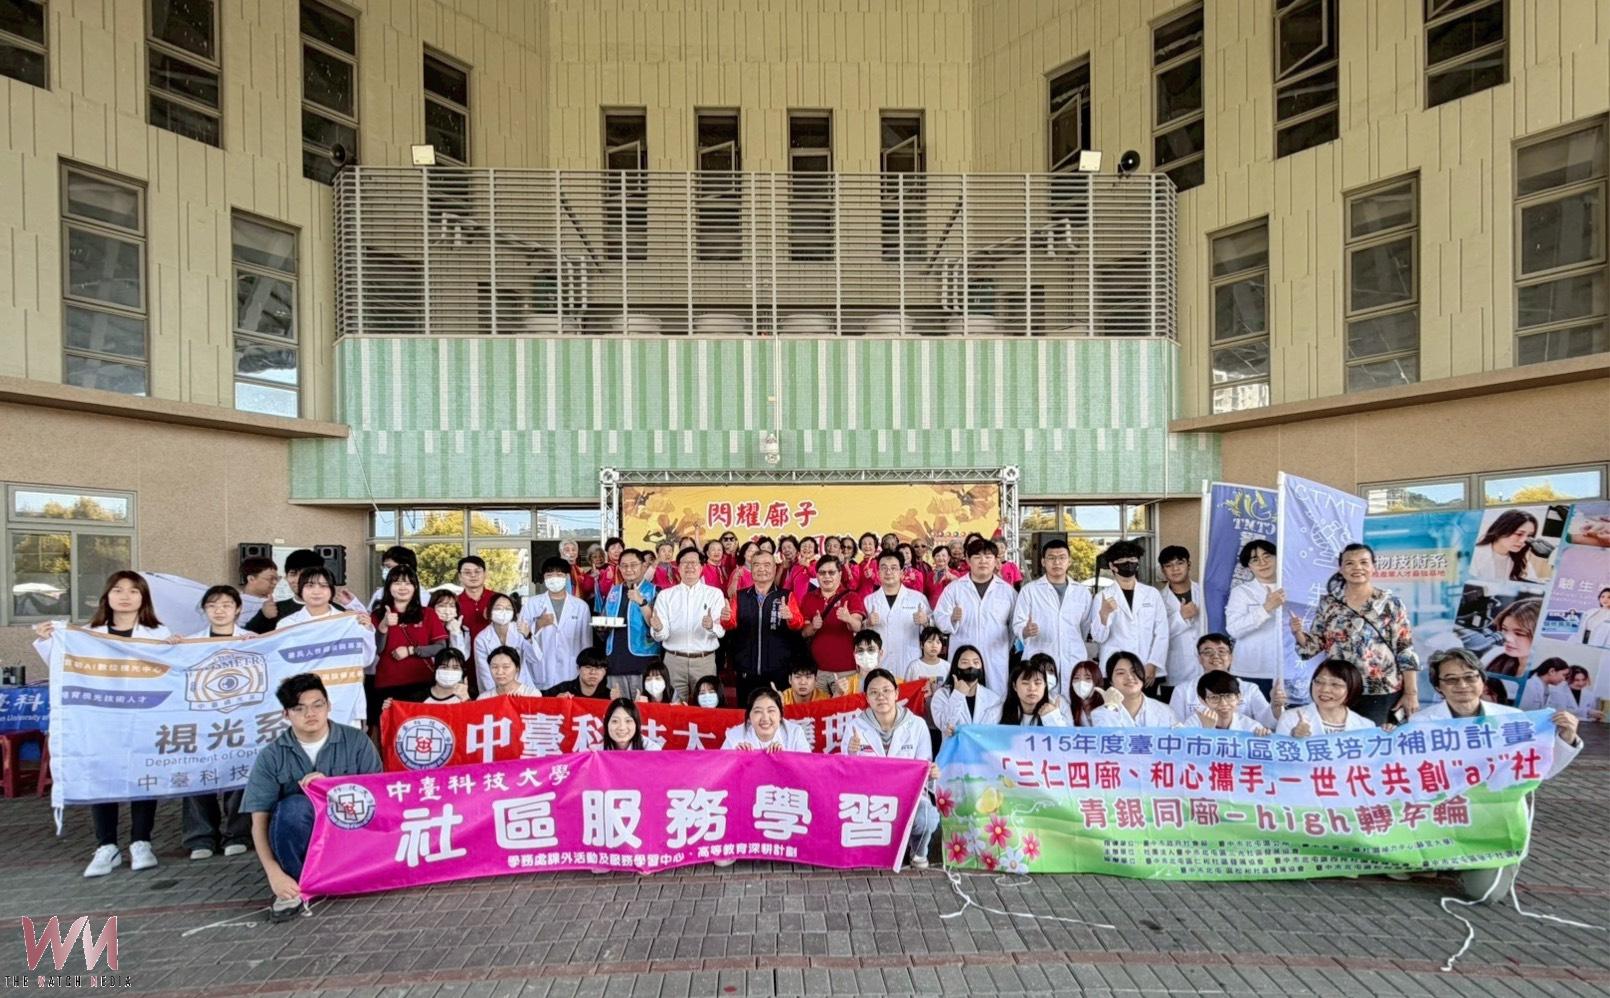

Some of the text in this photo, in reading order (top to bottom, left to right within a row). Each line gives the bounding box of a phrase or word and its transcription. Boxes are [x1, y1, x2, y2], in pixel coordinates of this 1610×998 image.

[707, 501, 817, 528] 閃耀廍子
[1294, 484, 1363, 517] CTMT
[1374, 553, 1448, 570] 物技術系
[155, 710, 291, 755] 視光系
[1025, 721, 1536, 762] 115年度臺中市社區發展培力補助計畫
[145, 748, 259, 767] Department of Opt
[138, 764, 249, 791] 中臺科技
[387, 764, 571, 802] 中臺科技大學
[395, 785, 898, 867] 社區服務學習
